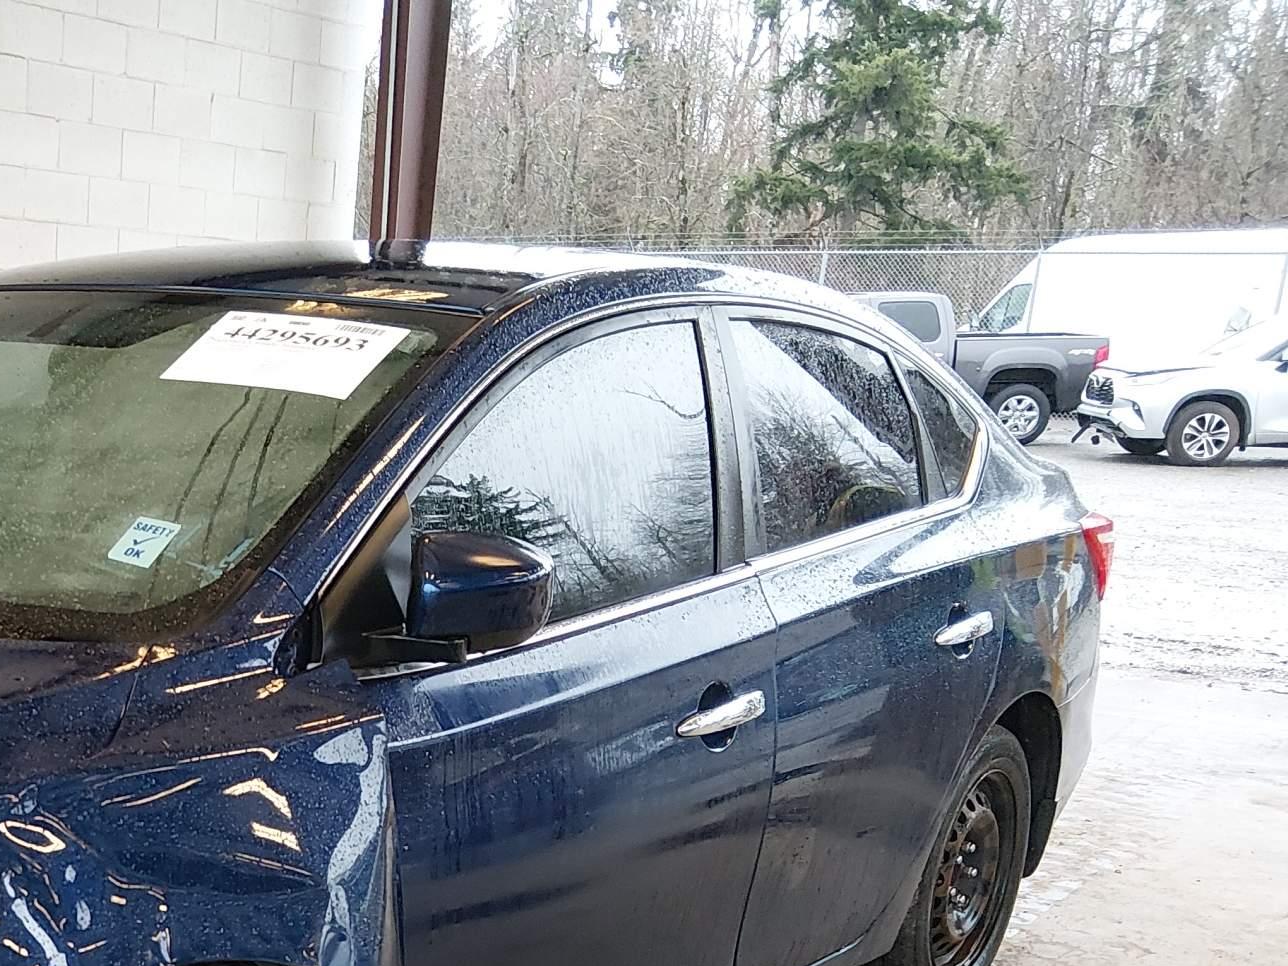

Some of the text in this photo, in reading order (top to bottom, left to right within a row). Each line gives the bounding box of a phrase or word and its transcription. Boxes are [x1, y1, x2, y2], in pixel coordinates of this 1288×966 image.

[224, 326, 369, 351] 44295693
[133, 521, 175, 538] SAFETY
[124, 547, 145, 559] OK
